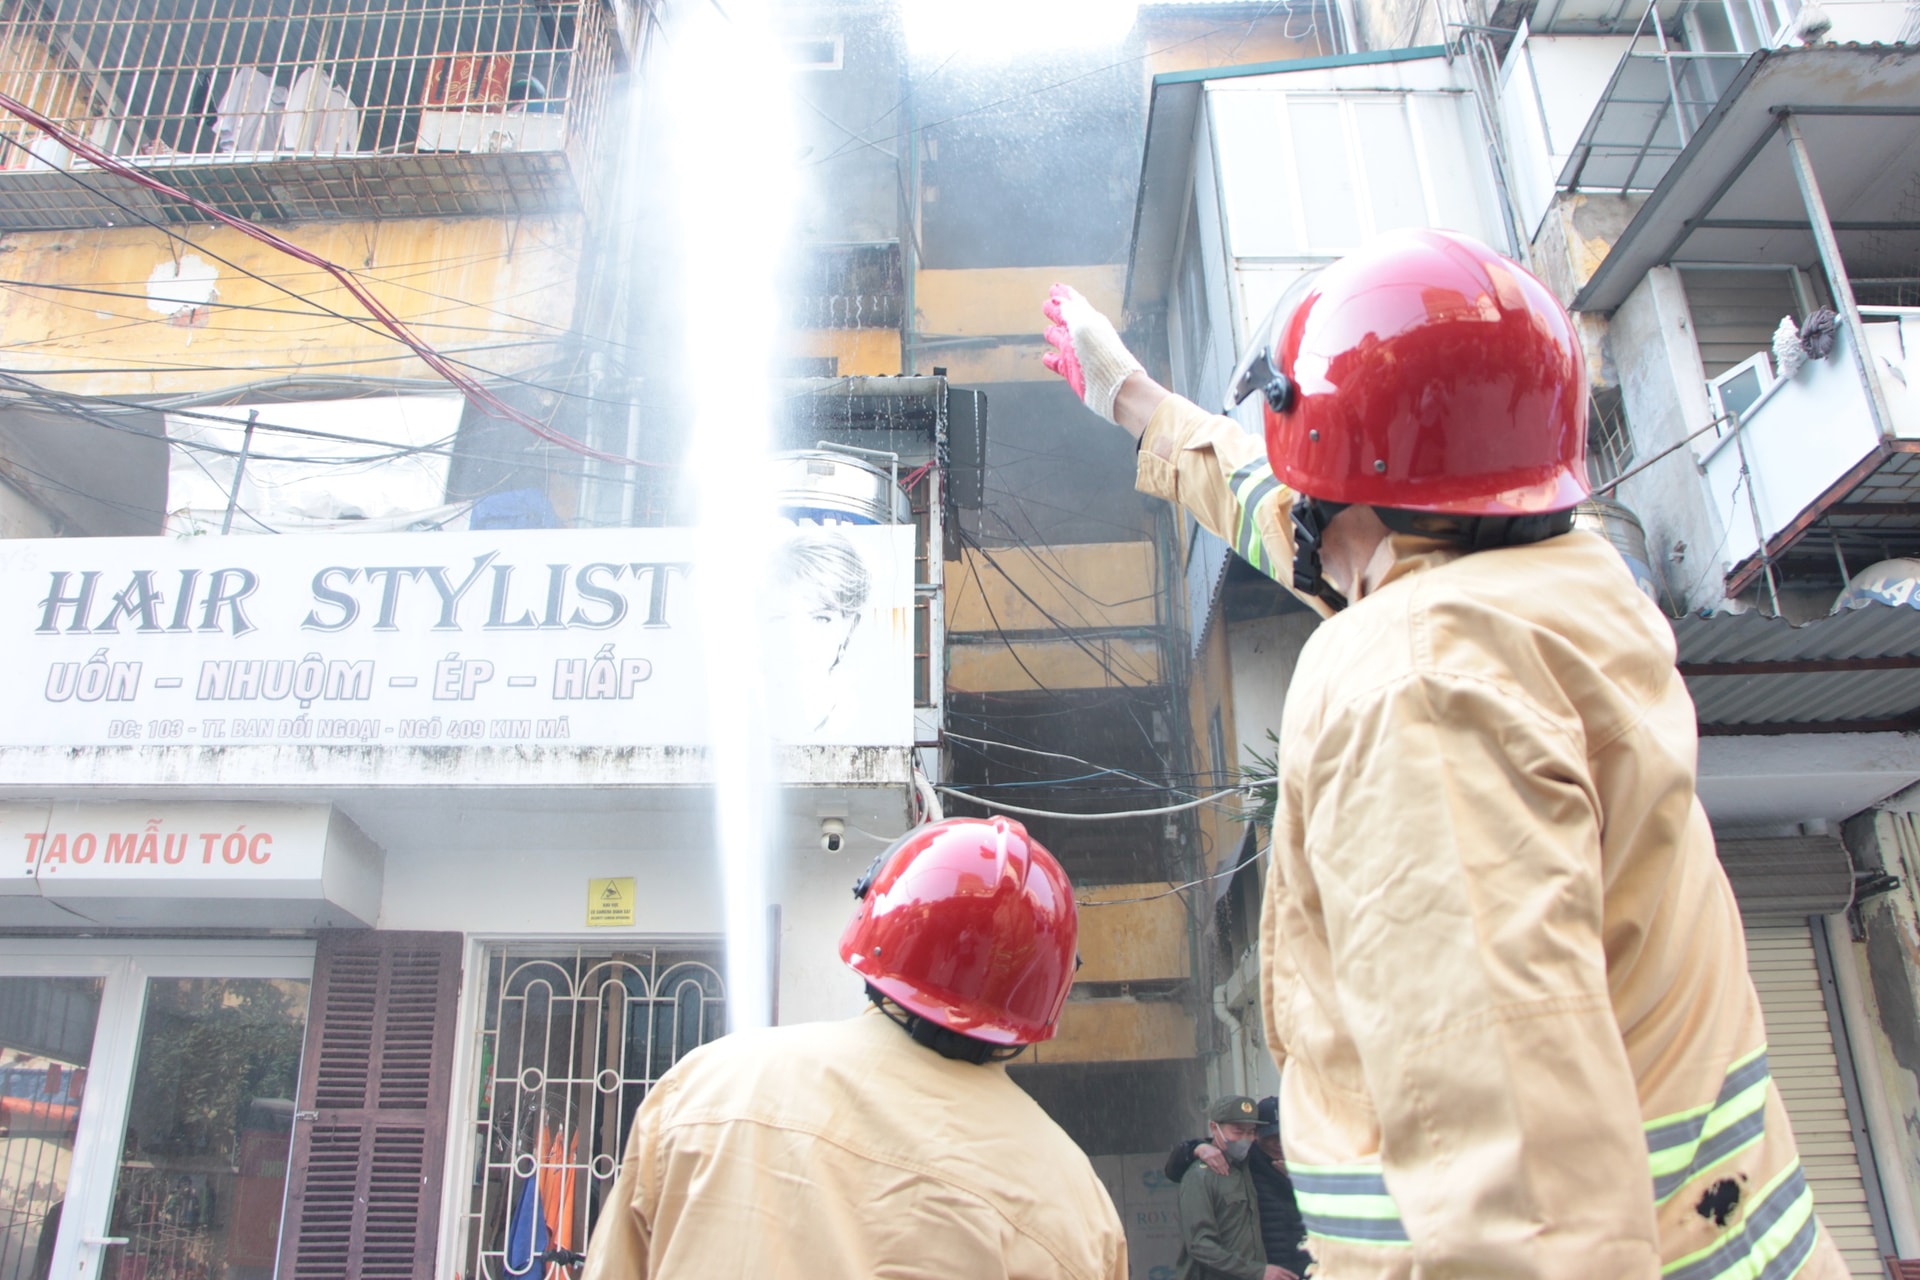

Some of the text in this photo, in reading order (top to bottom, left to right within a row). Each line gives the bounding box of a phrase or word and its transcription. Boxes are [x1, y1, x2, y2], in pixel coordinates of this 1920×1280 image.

[34, 549, 695, 639] HAIR STYLIST
[45, 647, 143, 702] UỐN
[195, 652, 376, 708] NHUỘM
[432, 652, 495, 701] ÉP
[552, 643, 653, 701] HẤP
[148, 719, 184, 739] 103
[231, 719, 275, 739] BAN
[278, 713, 314, 739] ĐỐI
[317, 718, 381, 743] NGOẠI
[398, 716, 442, 739] NGÕ
[447, 719, 486, 739] 409
[489, 719, 532, 739] KIM
[536, 715, 571, 739] MÃ
[24, 818, 273, 873] TẠO MẪU TÓC
[1136, 1210, 1181, 1226] ROYA
